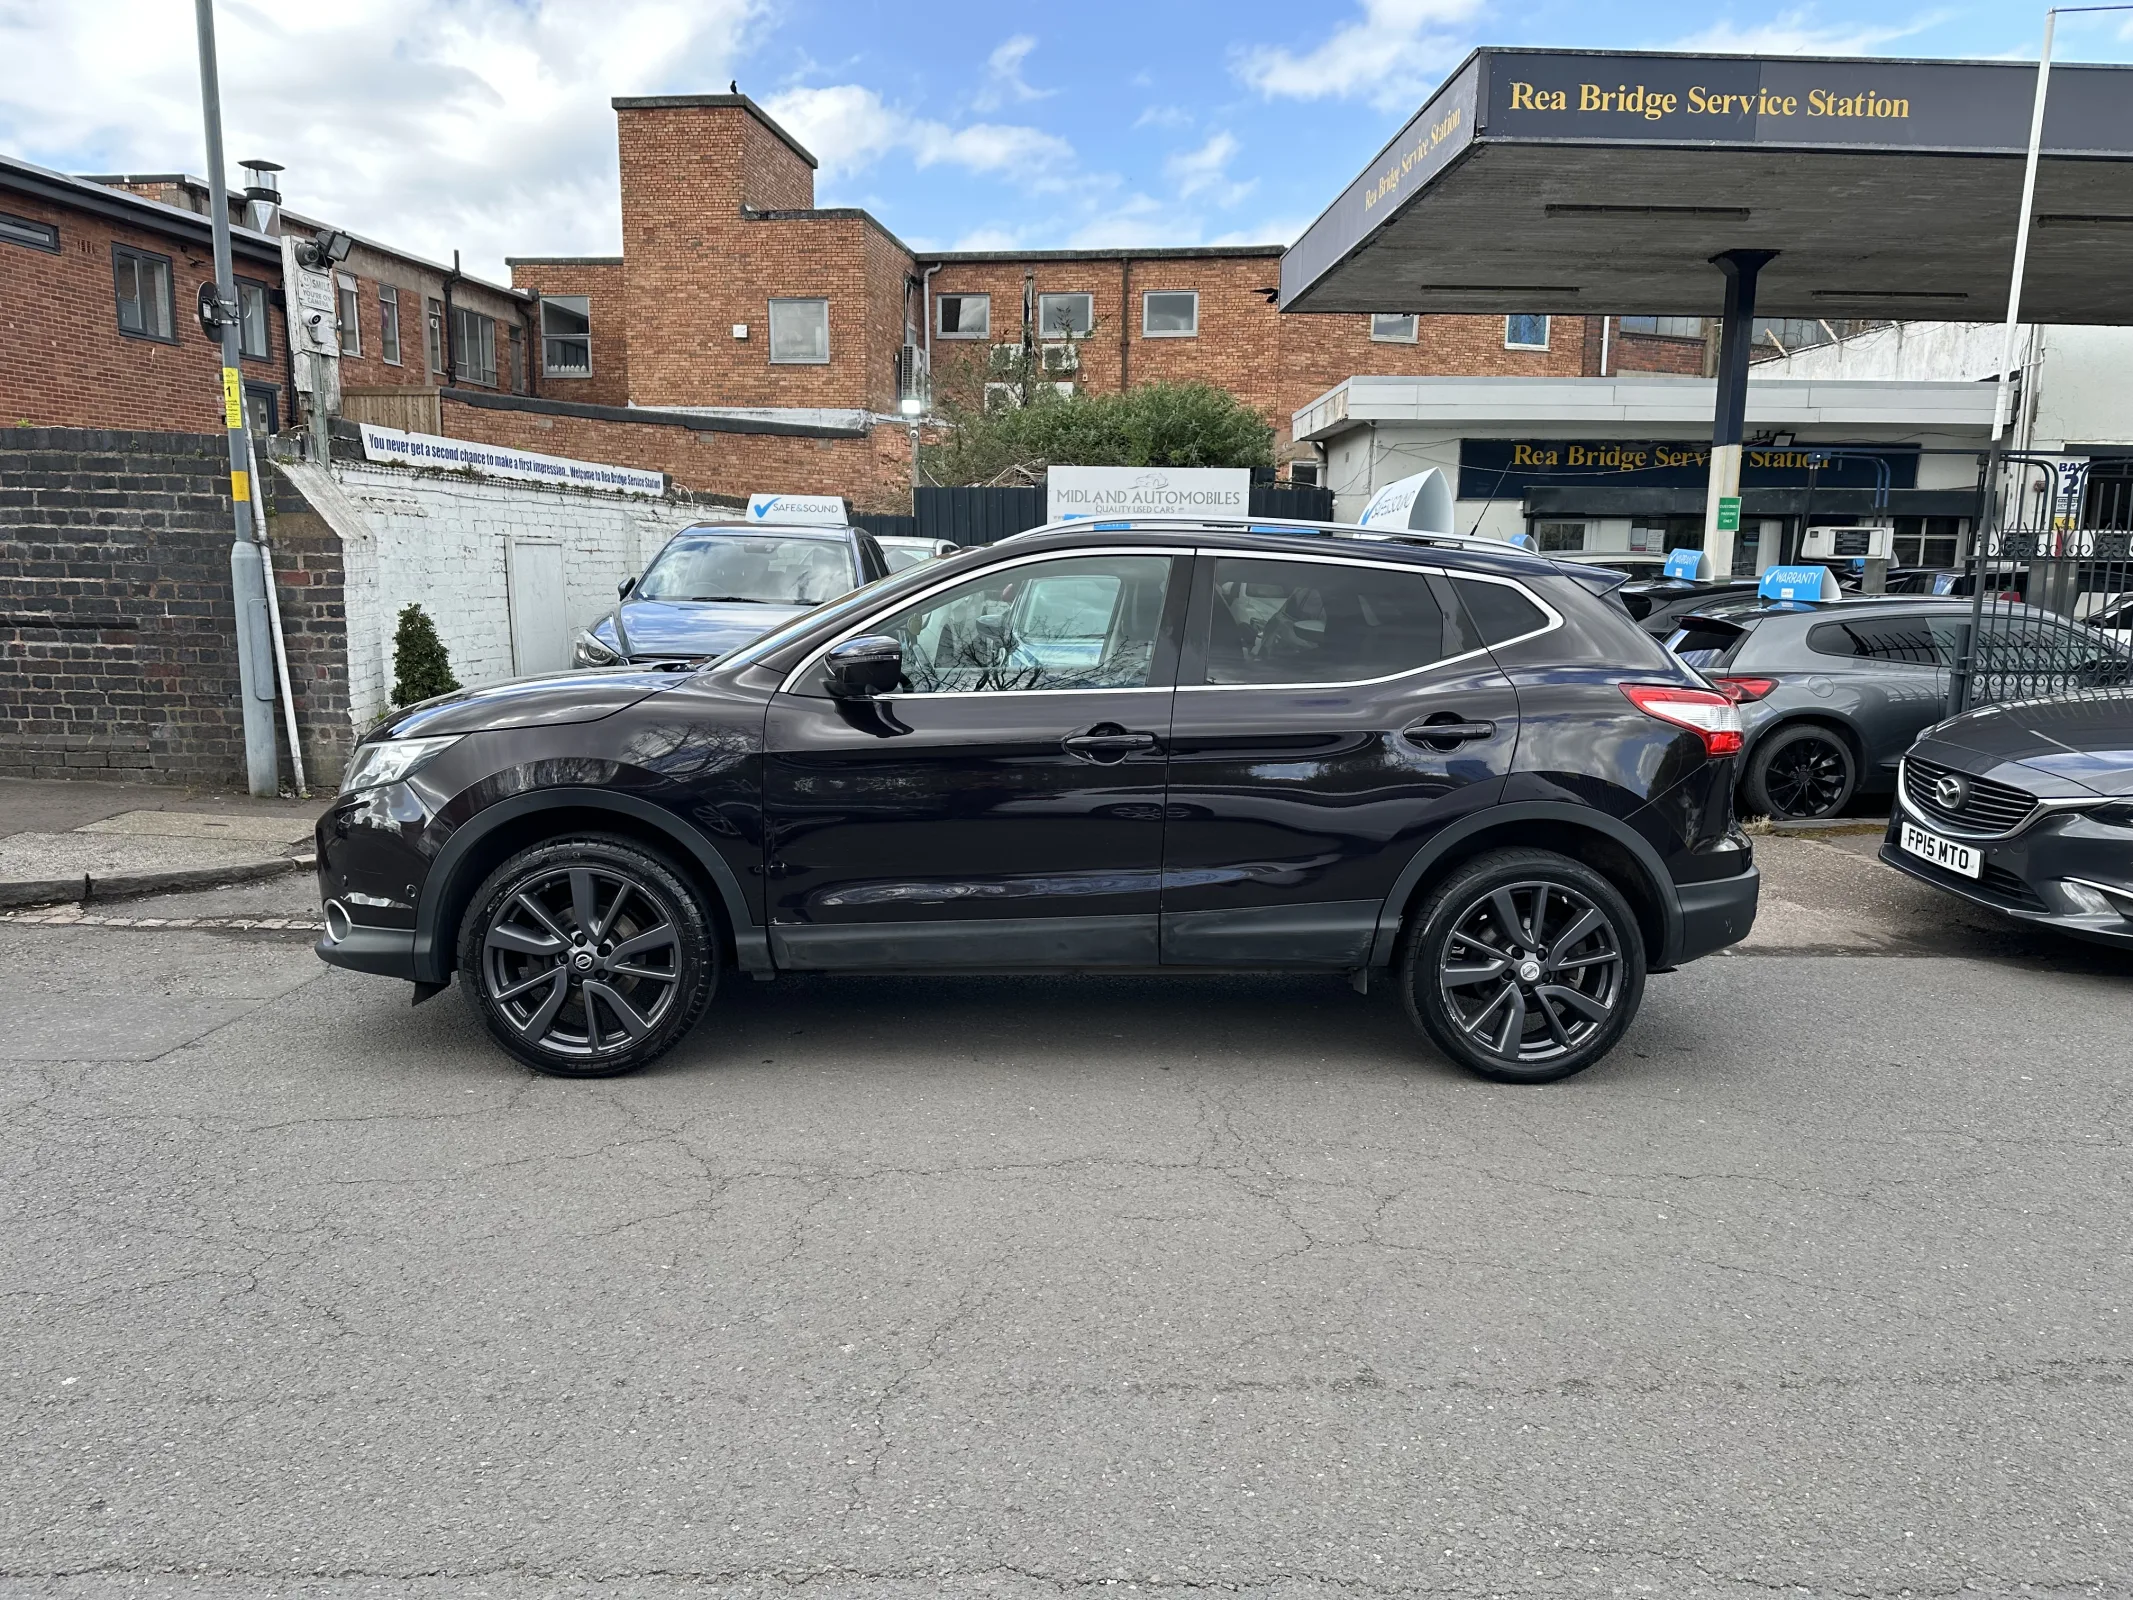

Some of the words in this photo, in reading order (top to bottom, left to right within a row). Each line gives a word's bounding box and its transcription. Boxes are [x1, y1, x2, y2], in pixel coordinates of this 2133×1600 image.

[1508, 82, 1567, 110] Rea
[1577, 83, 1677, 120] Bridge
[1687, 86, 1797, 116] Service
[1807, 89, 1909, 118] Station
[1365, 189, 1377, 212] Rea
[1378, 166, 1400, 199] Bridge
[1401, 138, 1429, 178] Service
[1430, 107, 1461, 150] Station
[303, 289, 322, 300] YOU'RE
[307, 298, 330, 308] CAMERA
[226, 385, 231, 397] 1
[368, 433, 385, 449] You
[386, 439, 409, 454] never
[411, 442, 424, 456] get
[425, 445, 431, 456] a
[431, 445, 458, 461] second
[460, 448, 485, 464] chance
[486, 453, 494, 466] to
[495, 455, 513, 469] make
[513, 459, 518, 469] a
[518, 457, 533, 472] first
[570, 466, 595, 481] Welcome
[601, 471, 611, 483] Rea
[611, 472, 627, 486] Bridge
[627, 474, 645, 488] Service
[645, 477, 661, 489] Station
[1513, 444, 1558, 466] Rea
[1566, 446, 1647, 472] Bridge
[1654, 446, 1712, 467] Serv
[2062, 473, 2080, 494] 2
[1057, 489, 1127, 504] MIDLAND
[1131, 490, 1240, 505] AUTOMOBILES
[773, 503, 838, 513] SAFE&SOUND
[1096, 505, 1131, 514] QUALITY
[1154, 506, 1175, 514] CARS
[1674, 554, 1699, 566] WARRANTY
[1775, 571, 1820, 584] WARRANTY
[1907, 828, 1936, 857] FP15
[1938, 840, 1969, 870] MTO
